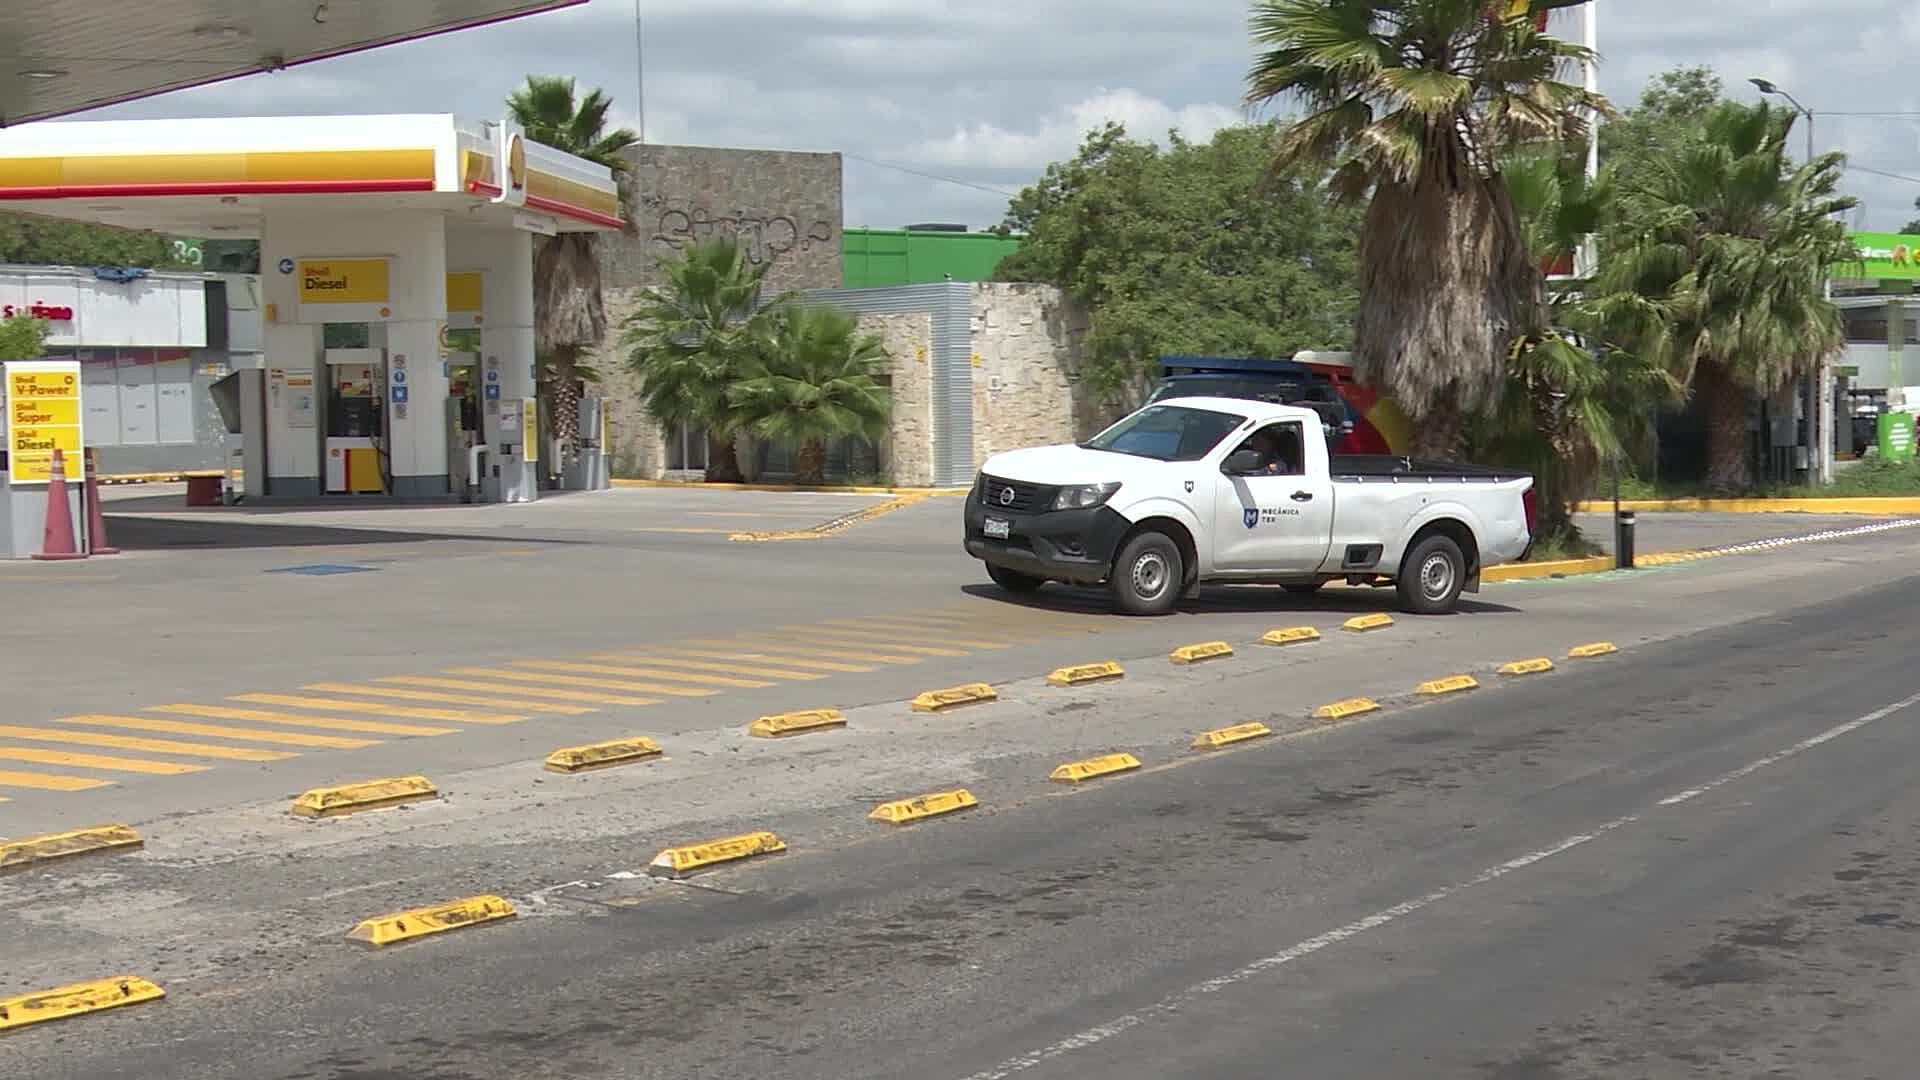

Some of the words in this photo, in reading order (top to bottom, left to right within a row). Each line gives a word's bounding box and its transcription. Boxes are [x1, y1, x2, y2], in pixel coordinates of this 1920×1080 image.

[304, 276, 347, 290] Diesel
[16, 385, 69, 395] V-Power
[16, 412, 52, 424] Super
[17, 438, 55, 450] Diesel
